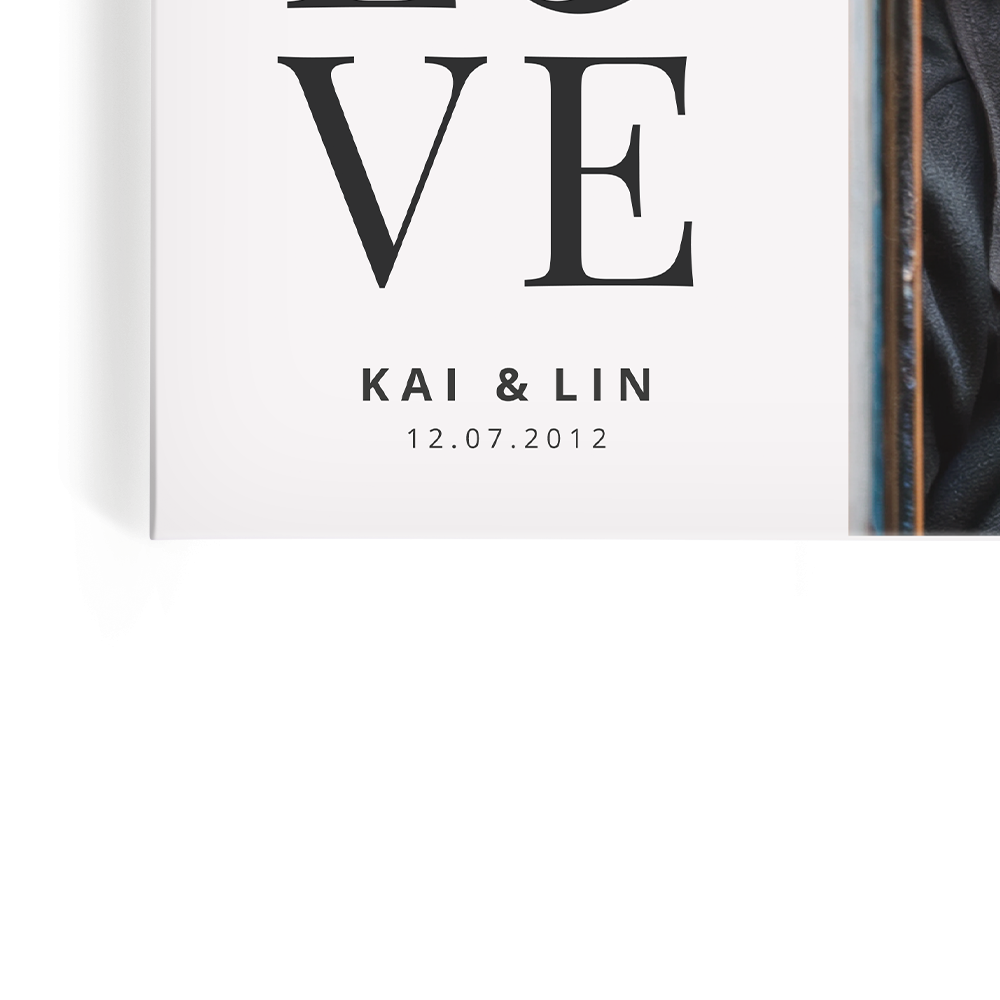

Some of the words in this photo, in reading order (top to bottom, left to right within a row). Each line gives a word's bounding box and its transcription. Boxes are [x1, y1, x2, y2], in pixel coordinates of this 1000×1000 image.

[277, 55, 694, 289] VE
[362, 367, 456, 402] KAI
[496, 367, 529, 402] &
[555, 367, 650, 402] LIN
[406, 427, 607, 449] 12.07.2012
